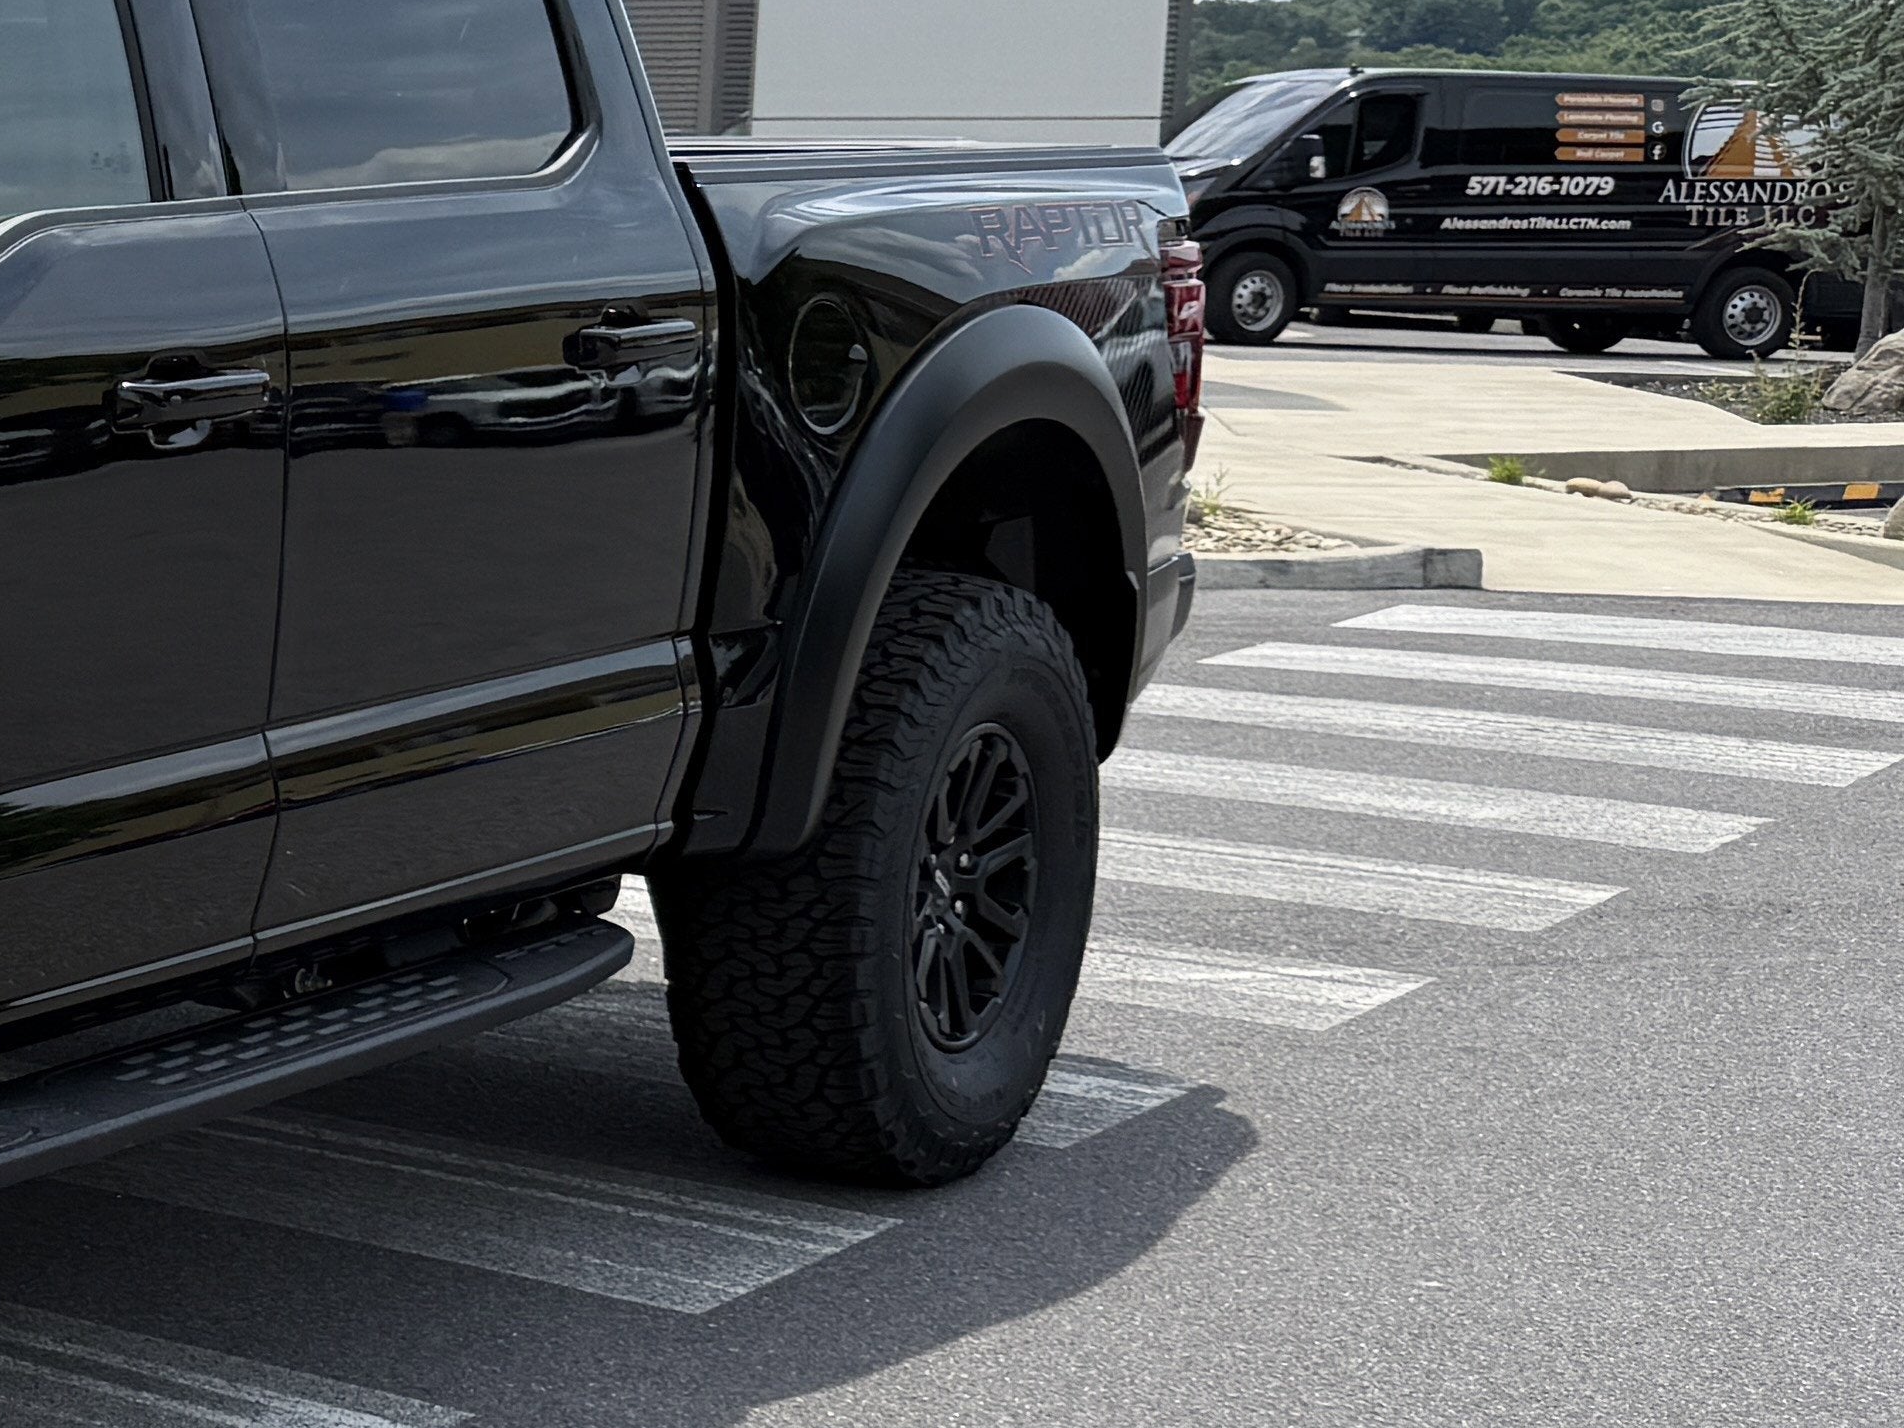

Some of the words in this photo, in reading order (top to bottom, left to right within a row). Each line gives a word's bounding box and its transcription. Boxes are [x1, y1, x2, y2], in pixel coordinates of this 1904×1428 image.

[1465, 175, 1615, 196] 571-216-1079
[1686, 205, 1750, 226] TILE
[1763, 205, 1817, 227] LLC
[968, 199, 1158, 275] RAPTOR
